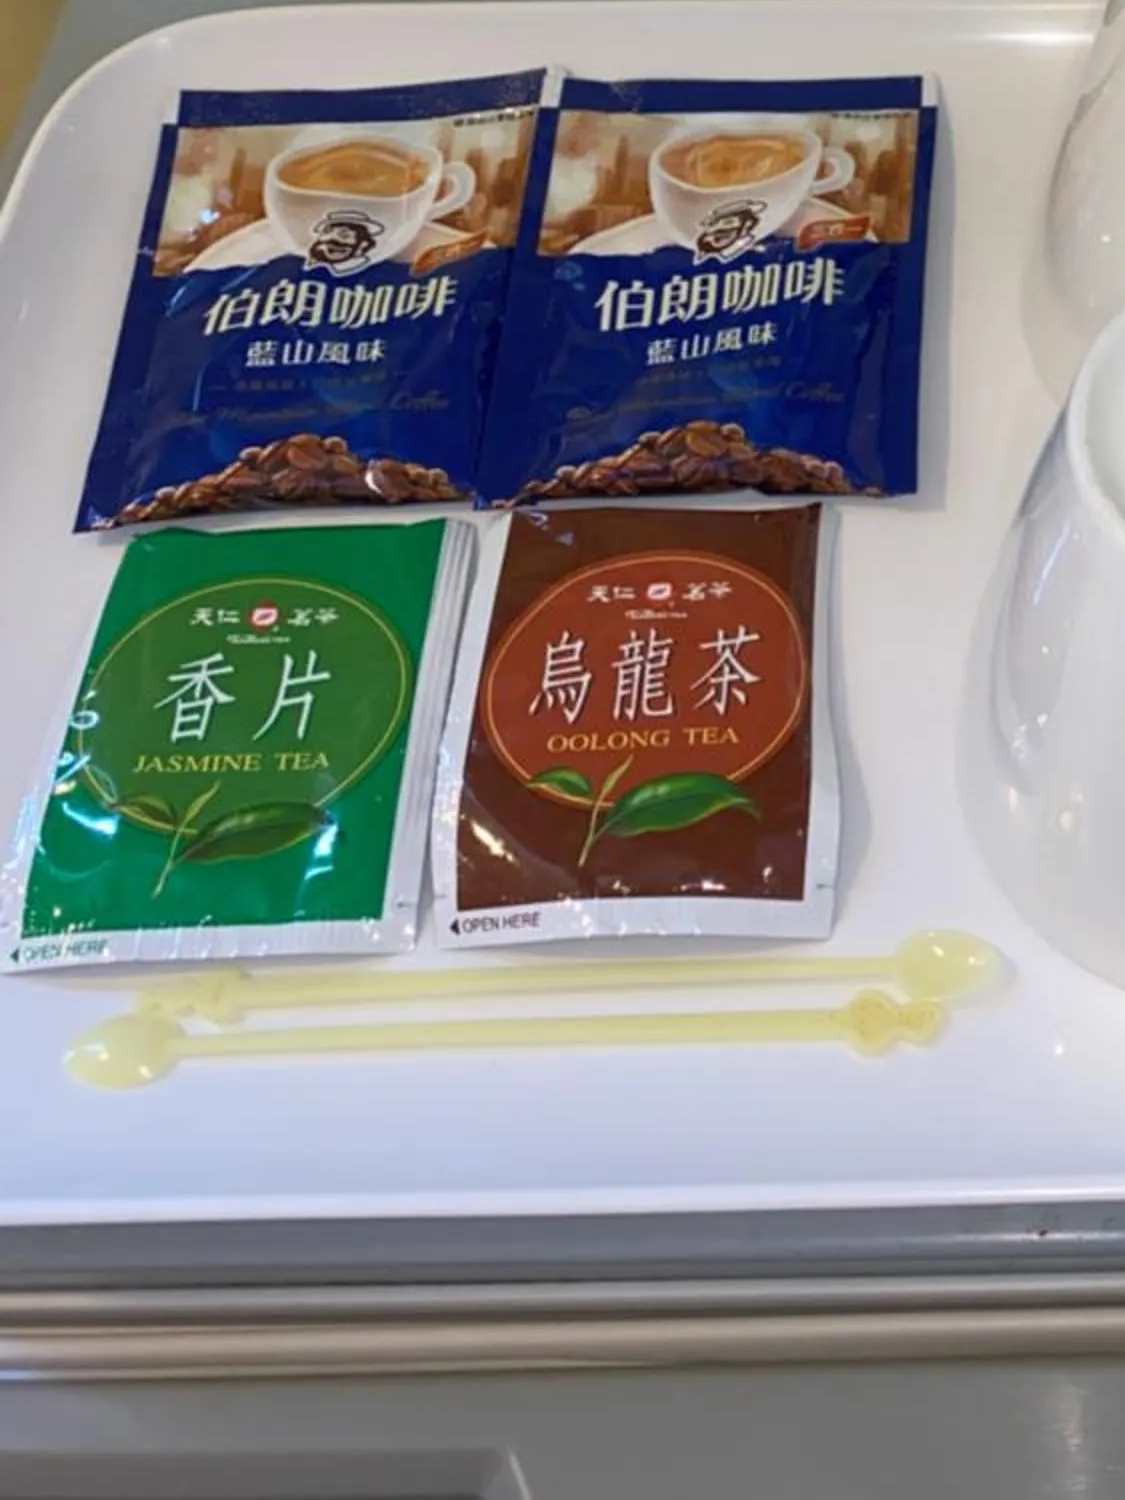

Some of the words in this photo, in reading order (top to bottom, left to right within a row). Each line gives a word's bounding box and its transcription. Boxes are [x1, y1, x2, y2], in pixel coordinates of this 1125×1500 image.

[204, 277, 458, 336] 伯朗咖啡
[595, 256, 845, 332] 伯朗咖啡
[246, 338, 386, 367] 藍山風味
[646, 322, 778, 367] 藍山風味
[153, 649, 332, 743] 香片
[529, 624, 763, 725] 烏龍茶
[133, 753, 261, 774] JASMINE
[275, 751, 331, 772] TEA
[546, 729, 671, 753] OOLONG
[683, 727, 740, 747] TEA
[462, 916, 500, 933] OPEN
[503, 912, 542, 930] HERE
